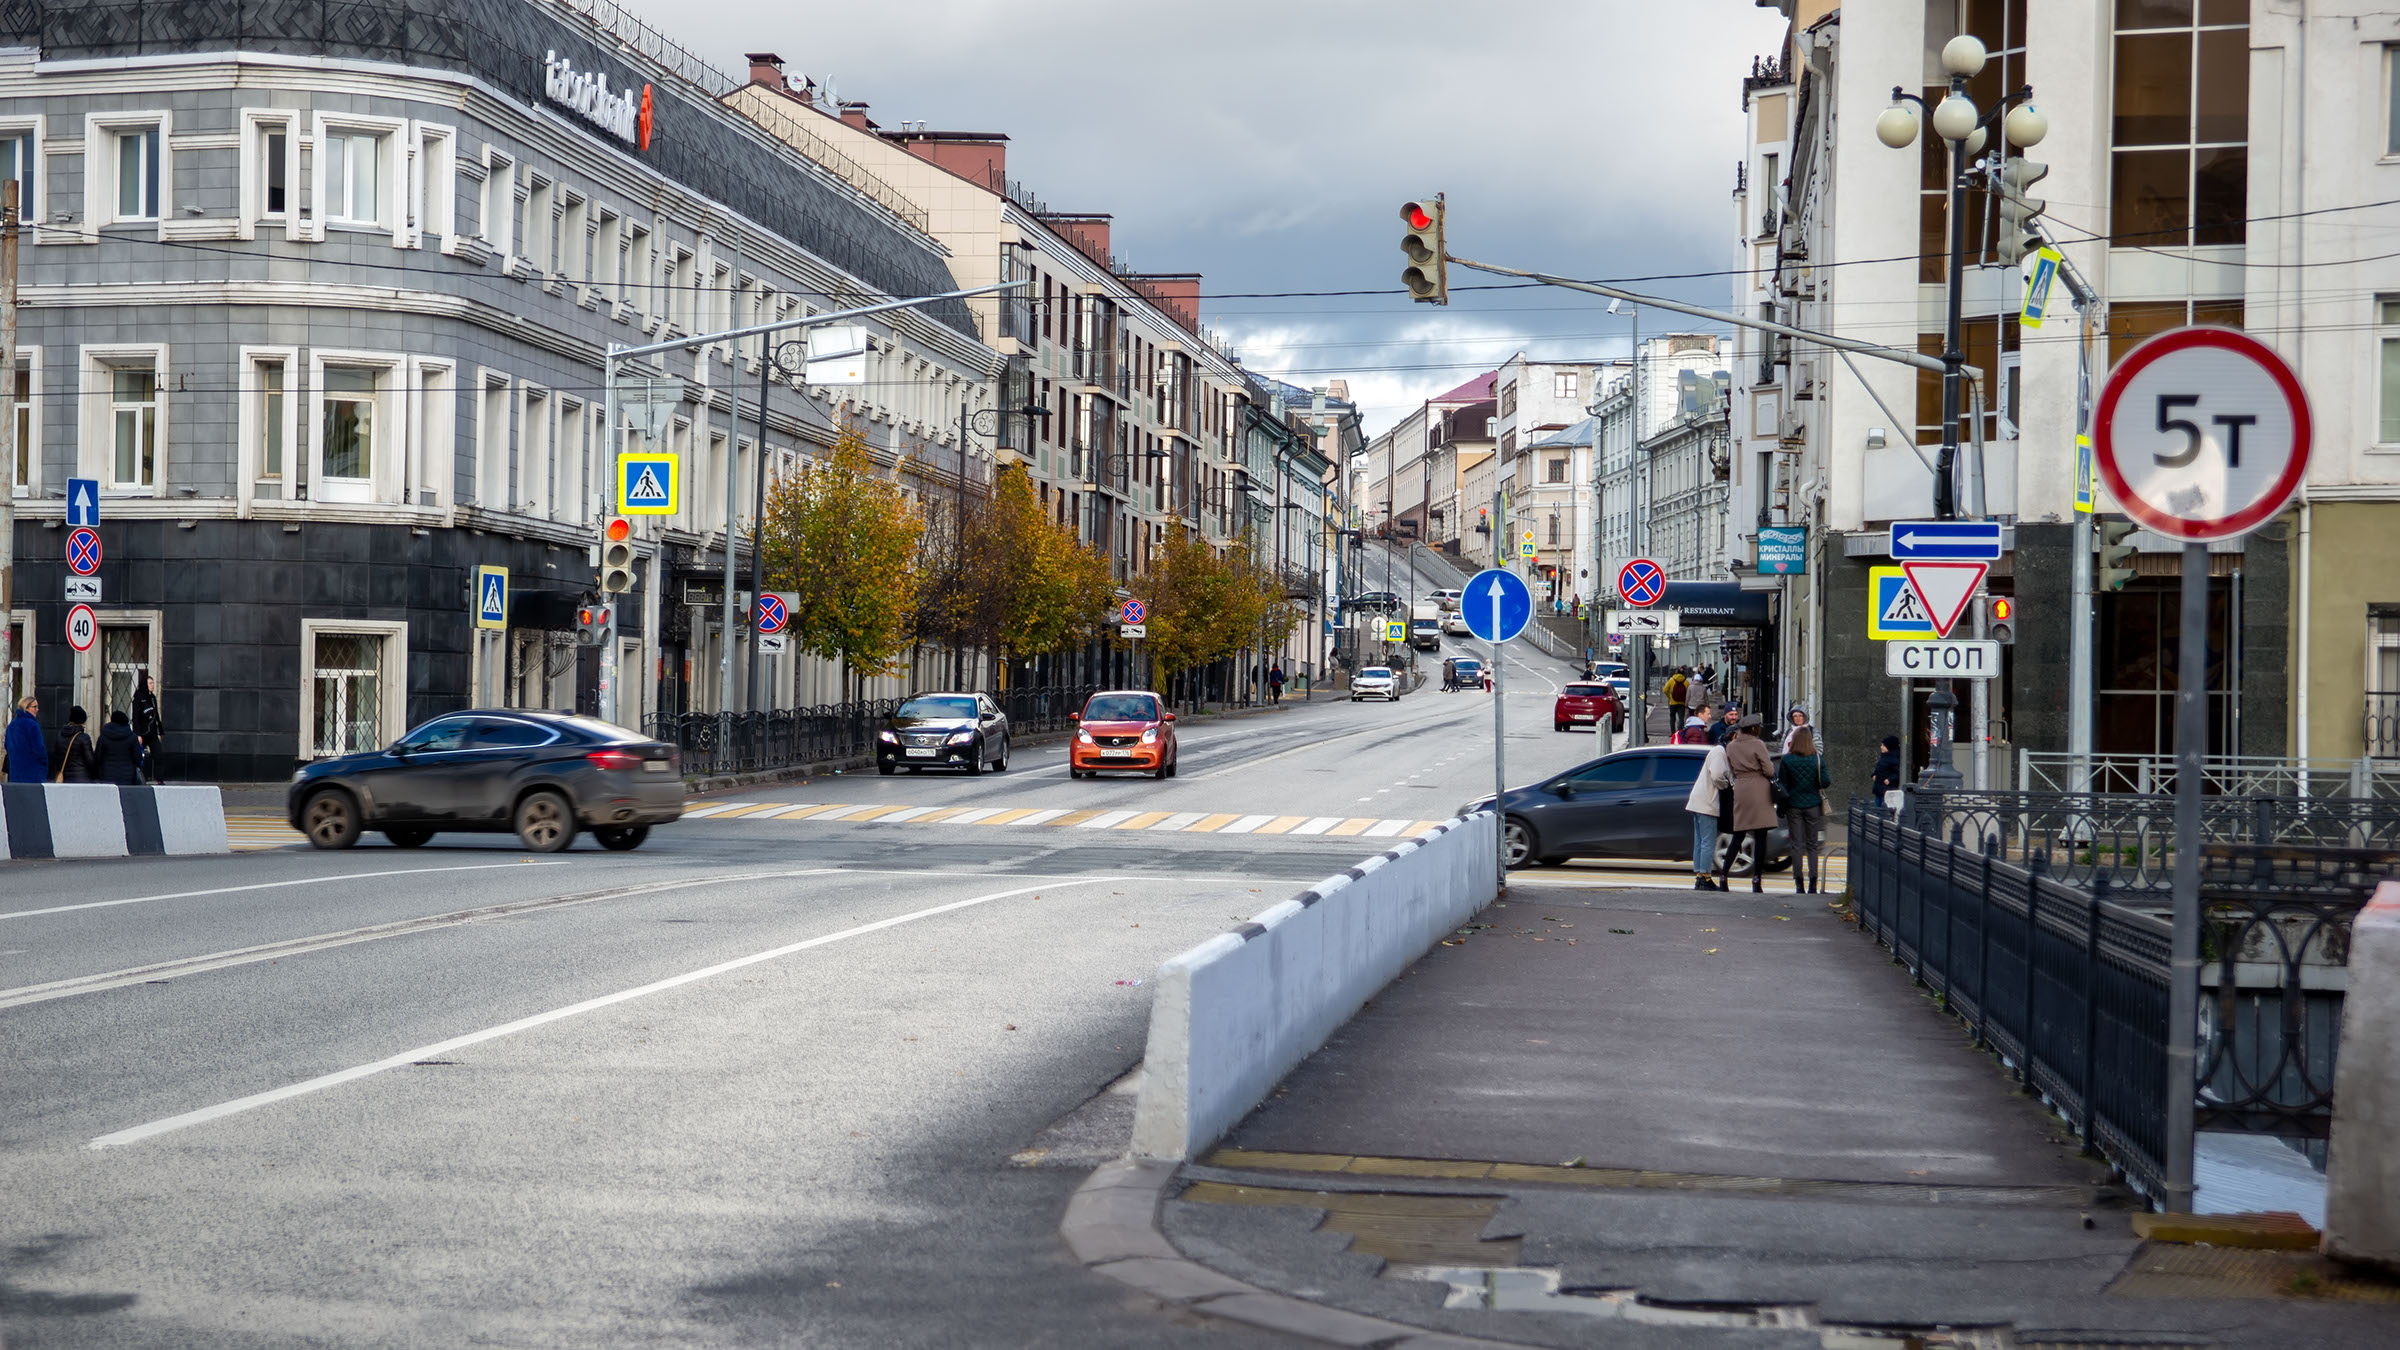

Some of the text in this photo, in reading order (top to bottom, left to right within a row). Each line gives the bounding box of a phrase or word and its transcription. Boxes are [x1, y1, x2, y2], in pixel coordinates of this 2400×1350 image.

[1758, 545, 1804, 553] КРИСТАЛЛЫ
[1760, 553, 1803, 561] МИНЕРАЛЫ
[1684, 607, 1735, 615] RESTAURANT
[74, 619, 89, 637] 40
[1903, 646, 1982, 670] СТОП
